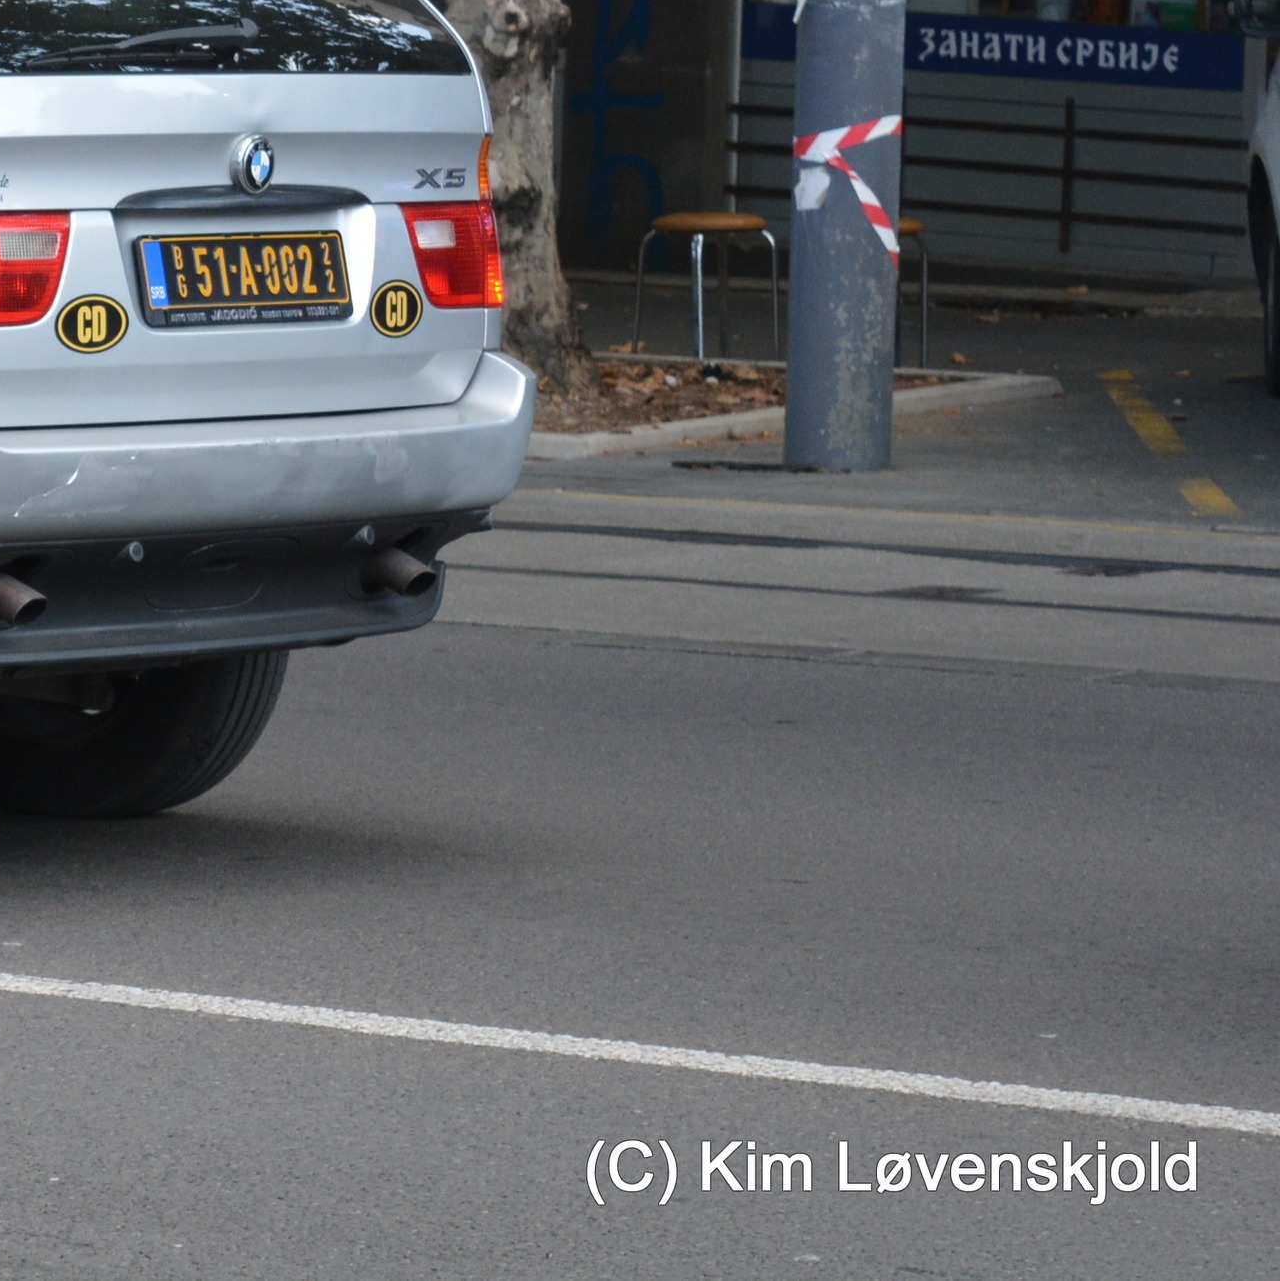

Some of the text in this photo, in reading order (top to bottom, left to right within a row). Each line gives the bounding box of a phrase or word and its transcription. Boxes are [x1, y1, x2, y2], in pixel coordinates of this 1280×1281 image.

[919, 27, 1179, 74] ЗАНАТИ СРБИЈЕ
[414, 167, 467, 190] X5
[150, 286, 166, 300] SRB
[386, 289, 408, 327] CD
[76, 305, 107, 343] CD
